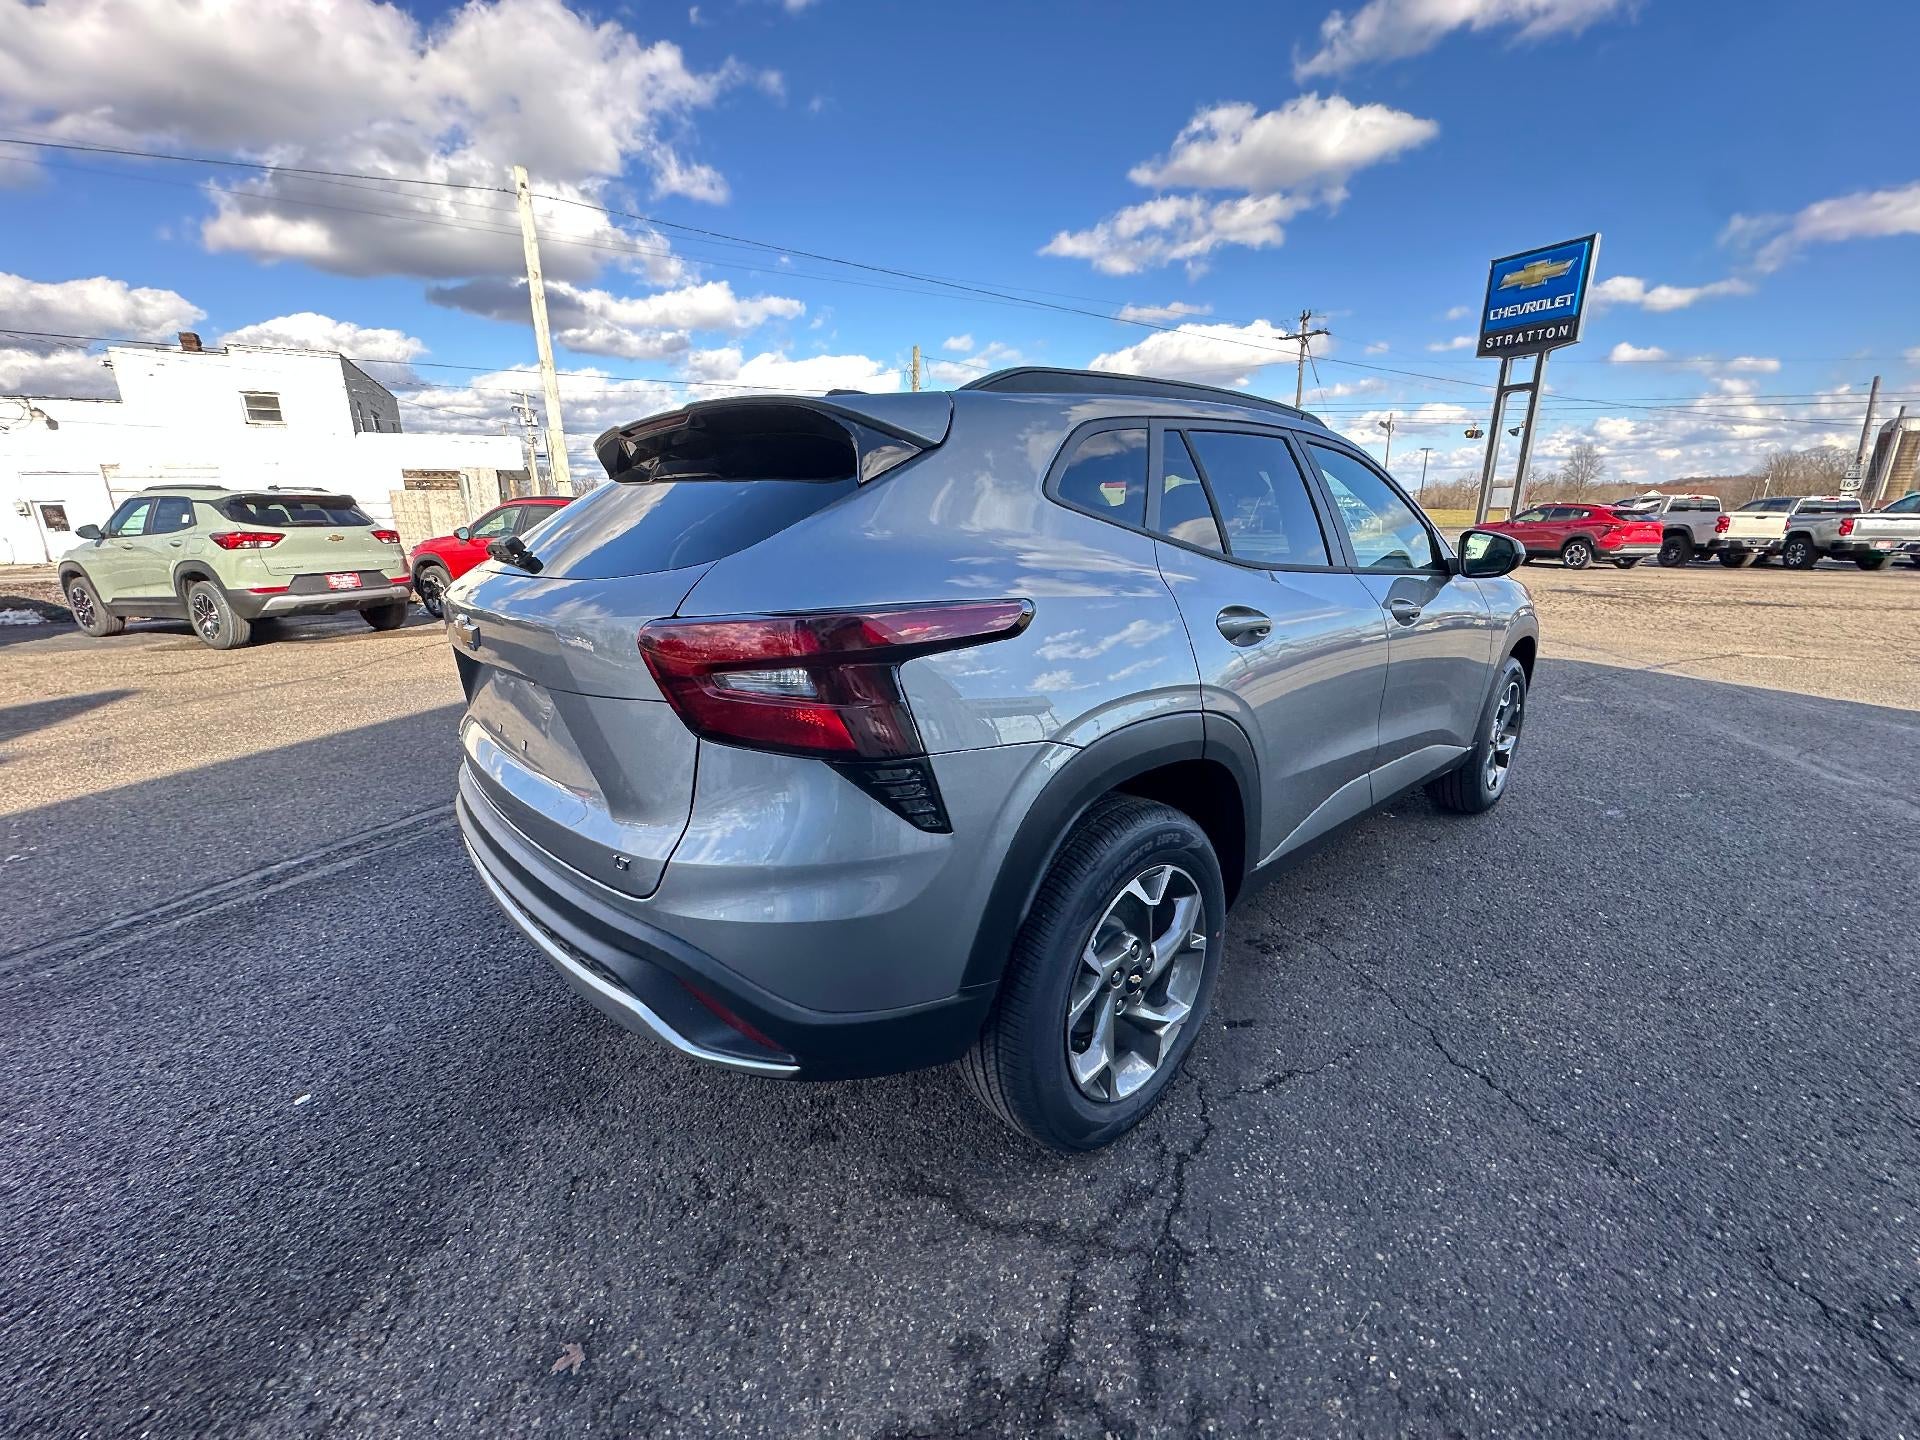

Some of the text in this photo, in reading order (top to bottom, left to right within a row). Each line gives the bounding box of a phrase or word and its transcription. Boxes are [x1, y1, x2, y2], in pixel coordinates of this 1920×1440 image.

[1489, 293, 1575, 320] CHEVROLET
[1485, 325, 1569, 348] STRATTON
[1842, 480, 1860, 488] 165
